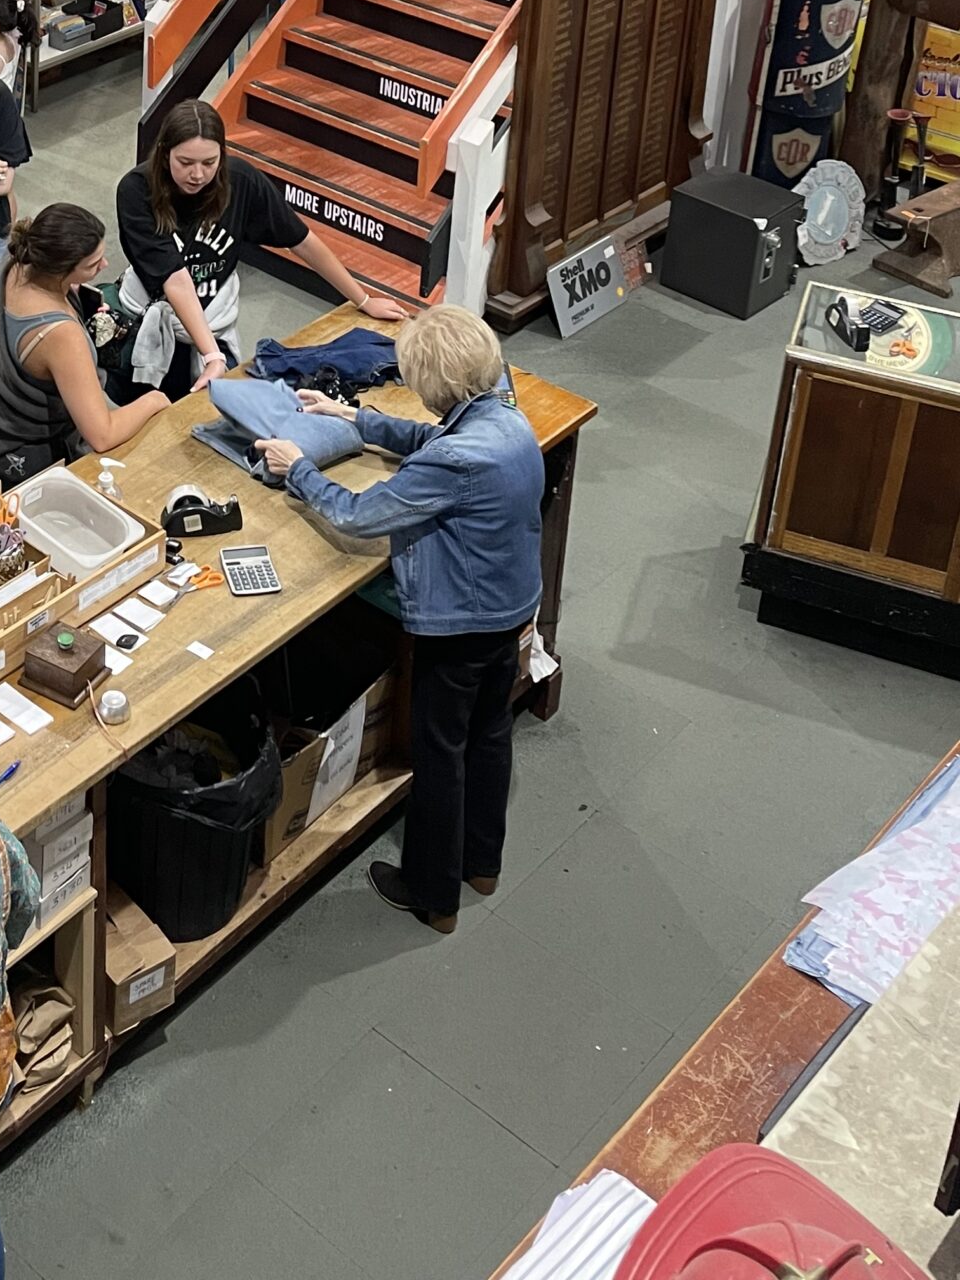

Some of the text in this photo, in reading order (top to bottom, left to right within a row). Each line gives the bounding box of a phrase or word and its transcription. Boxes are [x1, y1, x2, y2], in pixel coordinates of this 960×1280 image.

[779, 68, 823, 94] Plus
[776, 138, 811, 166] COR
[284, 183, 384, 242] MORE UPSTAIRS
[559, 257, 585, 283] Shell
[562, 261, 611, 309] XMO
